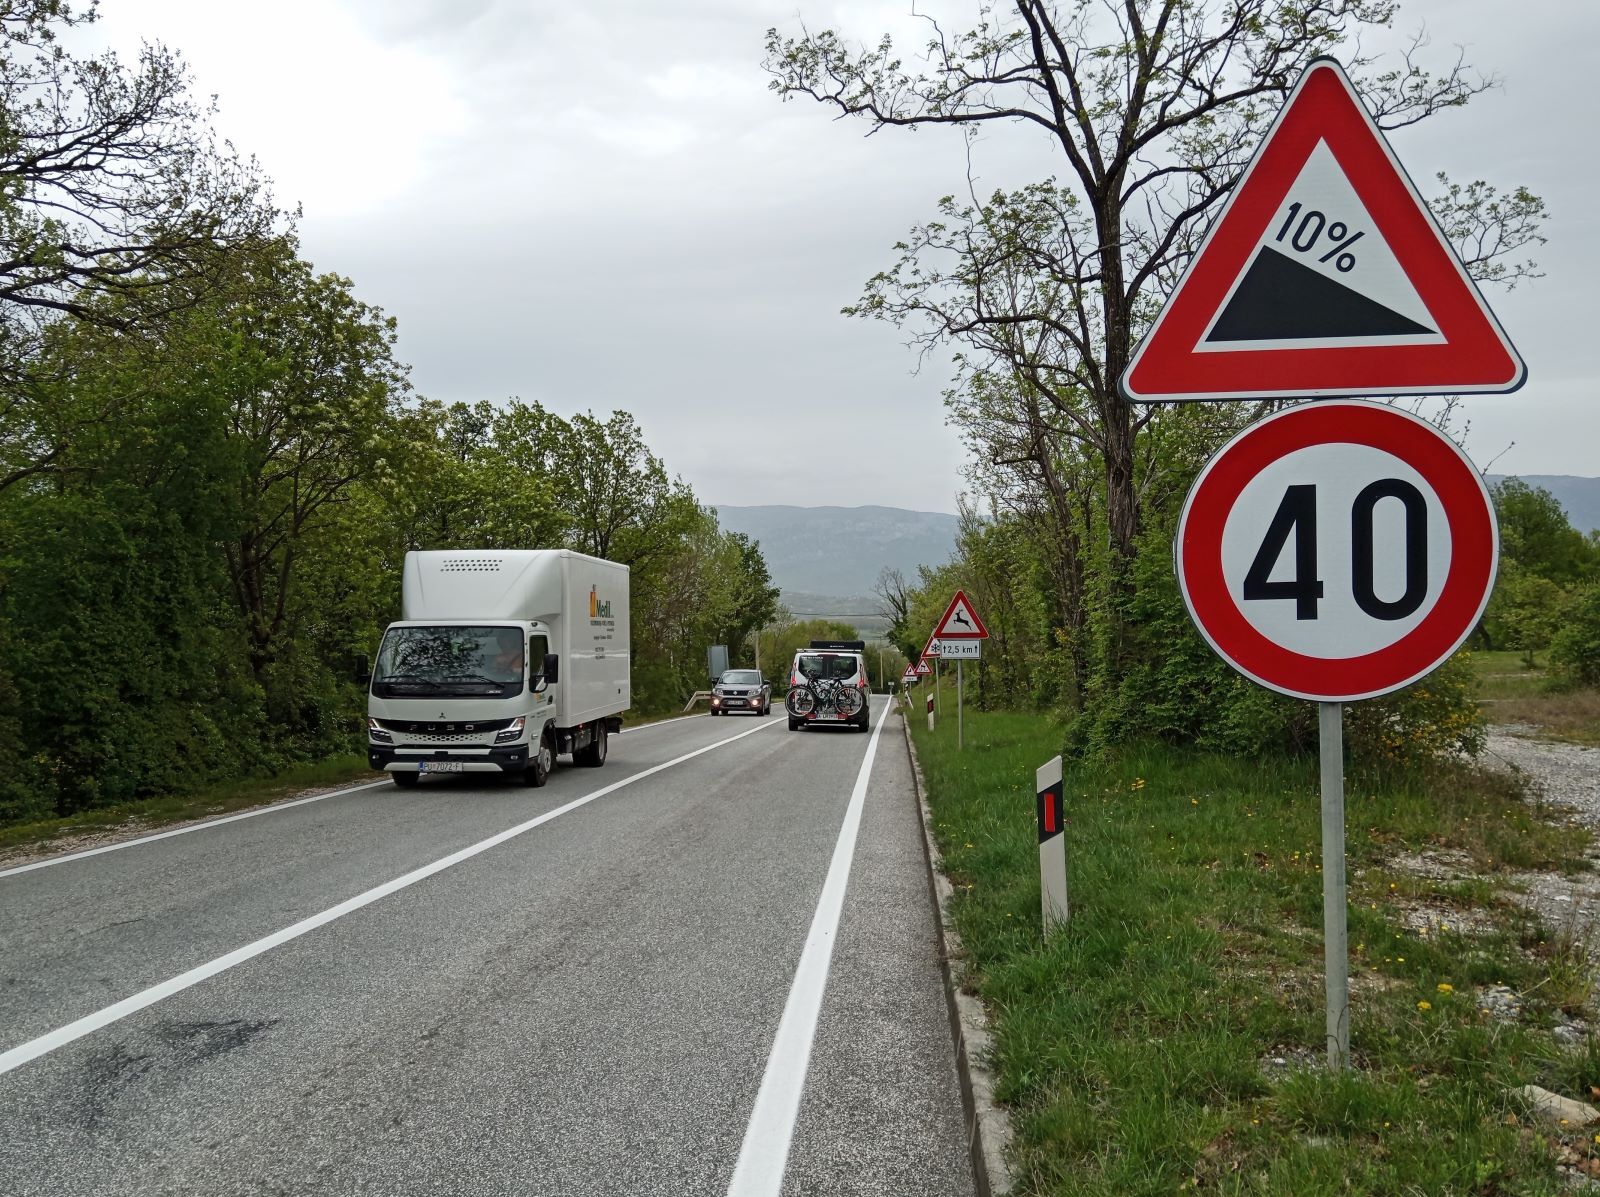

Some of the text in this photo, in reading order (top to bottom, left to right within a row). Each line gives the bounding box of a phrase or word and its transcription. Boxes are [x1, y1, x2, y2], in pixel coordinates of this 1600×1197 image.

[1276, 202, 1365, 273] 10%
[1243, 478, 1428, 621] 40
[947, 645, 973, 654] 2,5 km
